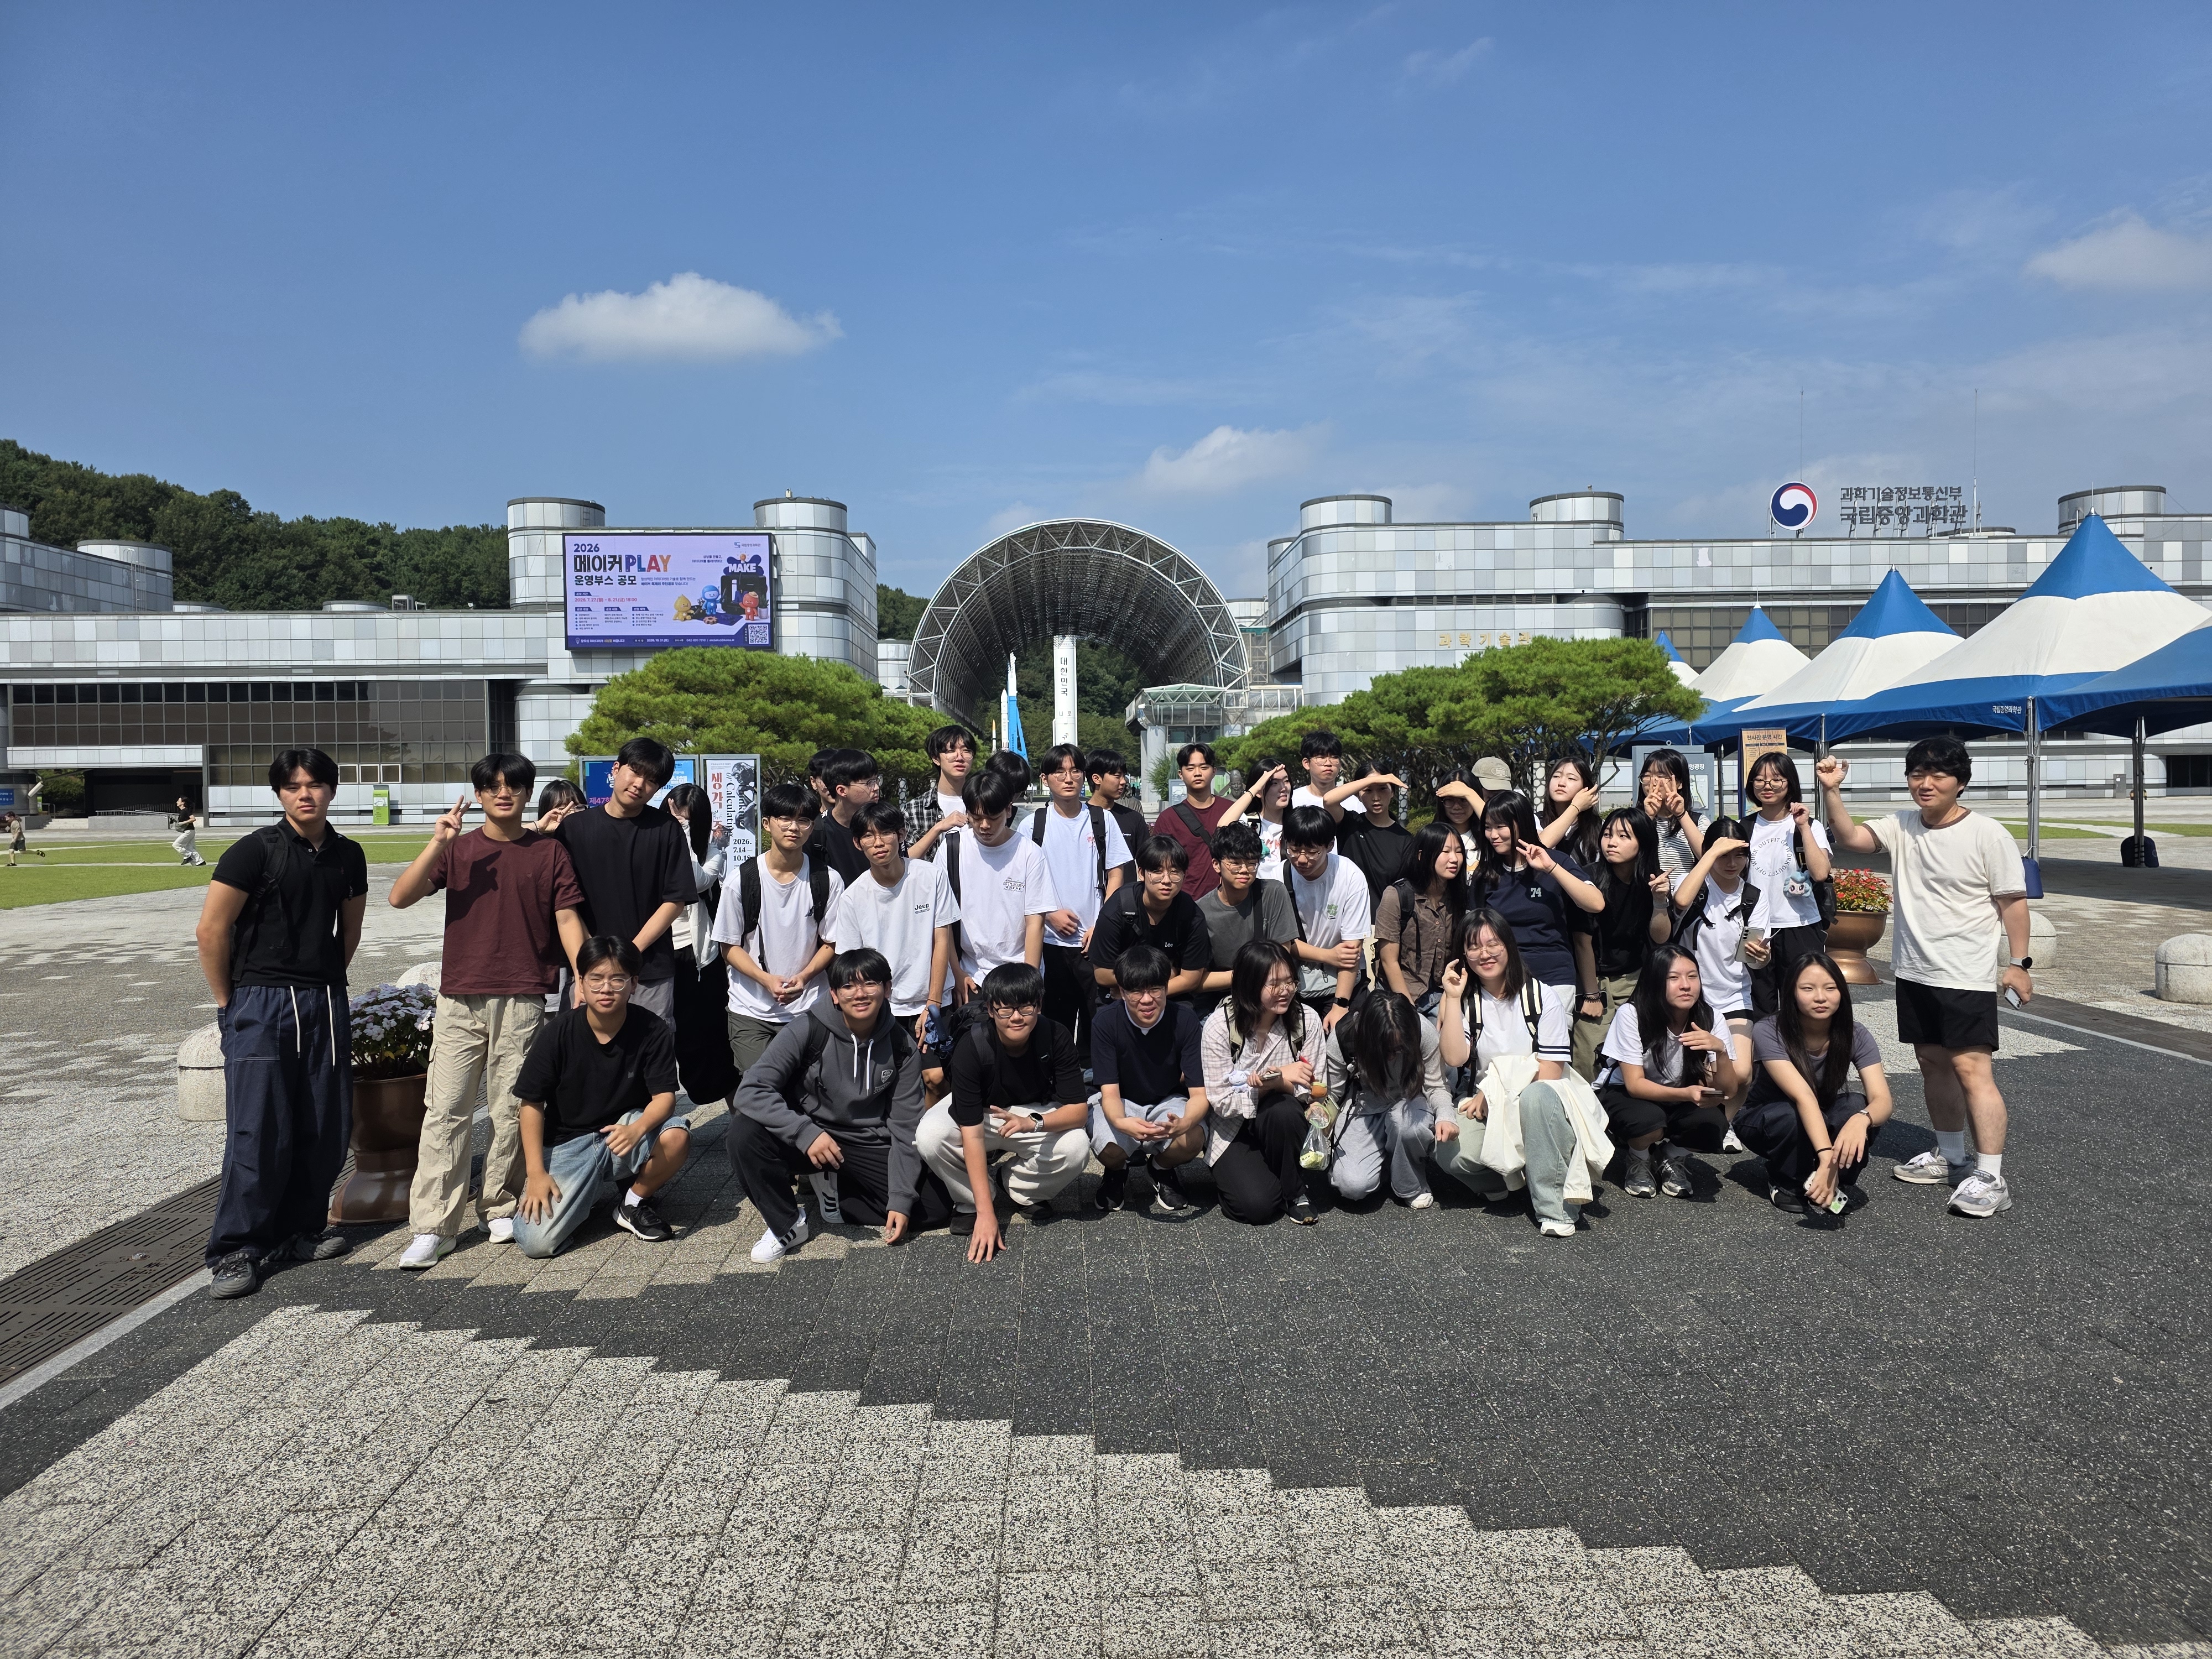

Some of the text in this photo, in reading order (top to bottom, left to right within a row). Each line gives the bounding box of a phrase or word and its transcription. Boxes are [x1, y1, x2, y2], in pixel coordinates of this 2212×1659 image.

[1840, 486, 1962, 502] 과학기술정보통신부
[1840, 505, 1968, 526] 국립중앙과학관
[573, 543, 600, 552] 2026
[728, 563, 757, 573] MAKE
[575, 575, 637, 586] 운영부스 공모
[1439, 632, 1532, 648] 과학기술관
[1992, 705, 2022, 714] 국립중앙과학관
[1530, 887, 1542, 898] 74
